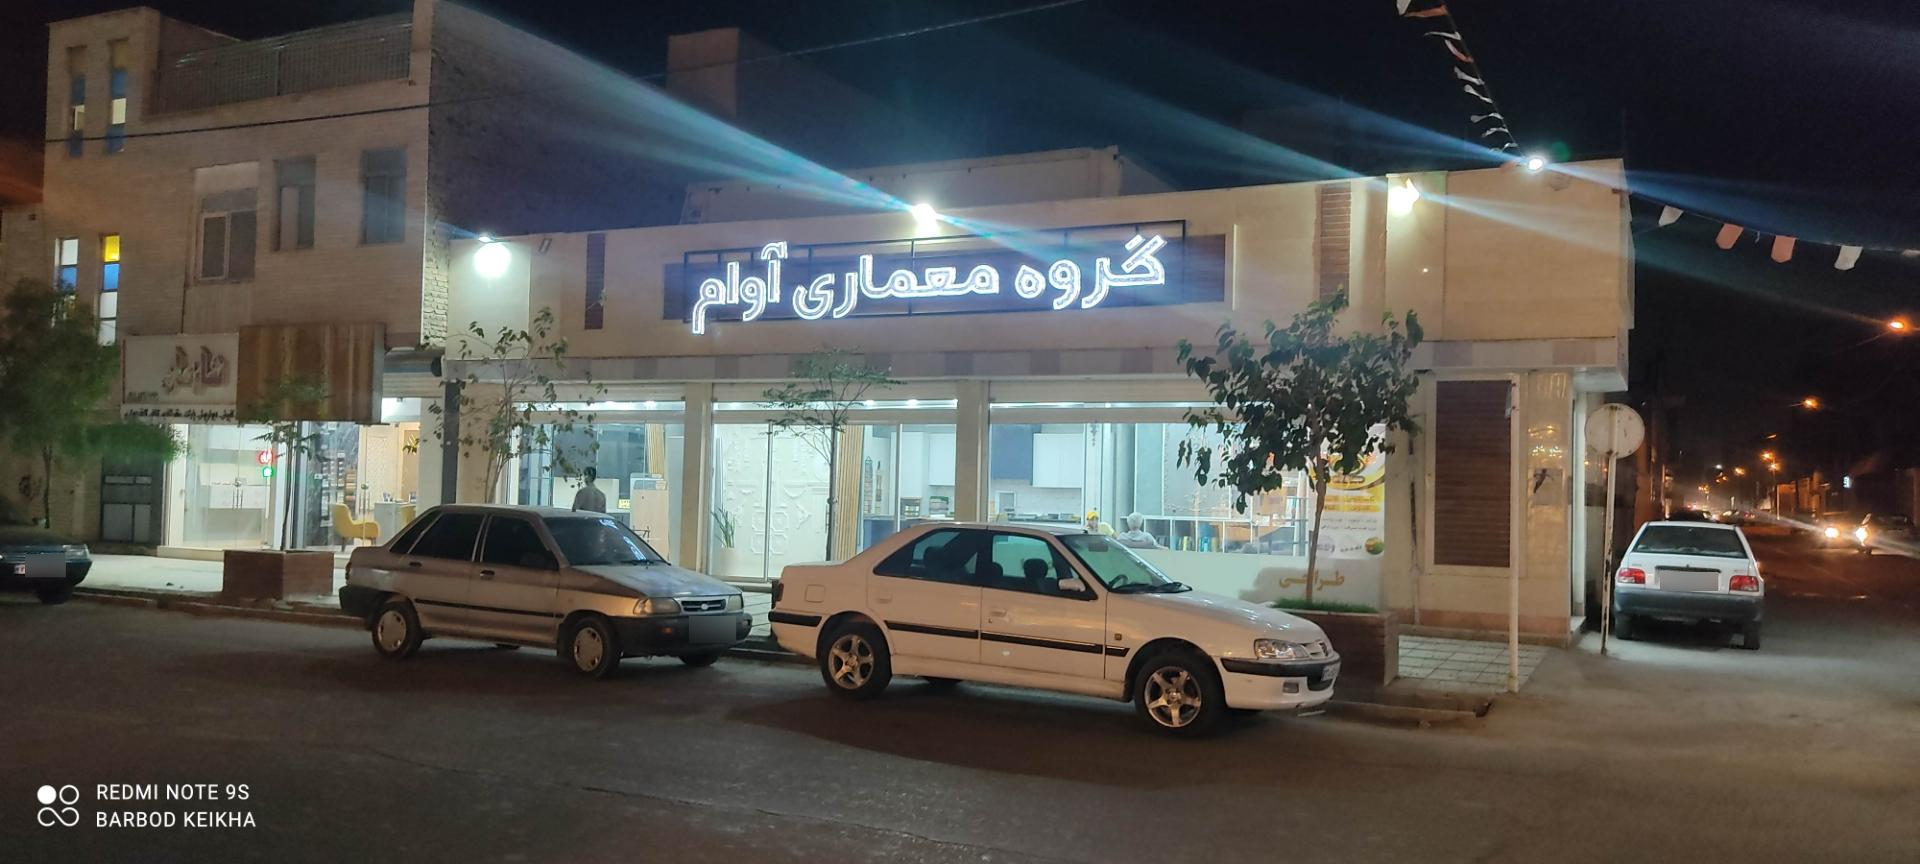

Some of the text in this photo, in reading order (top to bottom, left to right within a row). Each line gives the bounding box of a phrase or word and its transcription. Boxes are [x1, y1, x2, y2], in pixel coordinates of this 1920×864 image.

[691, 234, 1167, 335] گروه معماری آوام
[1279, 569, 1345, 591] طرای
